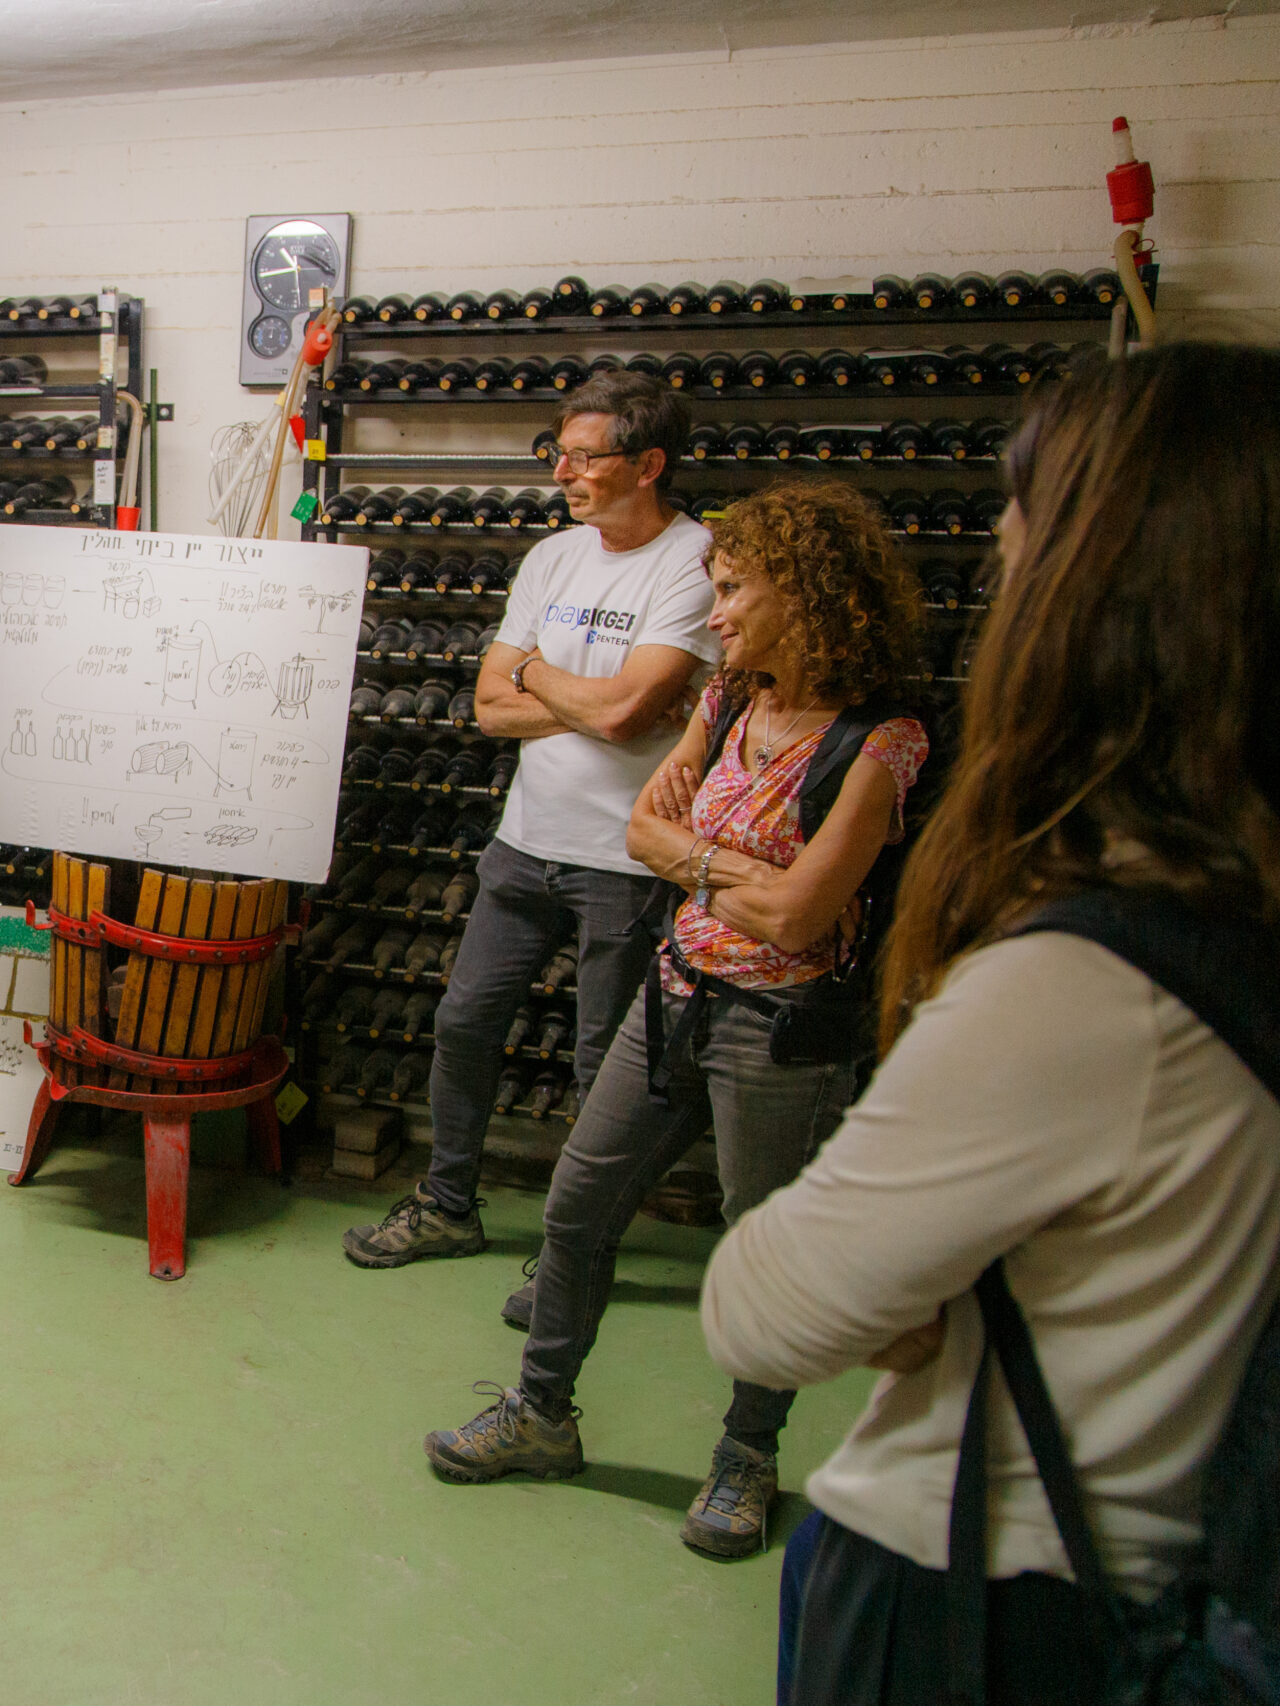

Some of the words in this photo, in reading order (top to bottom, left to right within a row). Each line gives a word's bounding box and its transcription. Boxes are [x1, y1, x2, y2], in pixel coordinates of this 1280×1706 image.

[81, 531, 122, 552] תהליך
[136, 538, 175, 559] ביתי
[185, 542, 202, 559] יין
[214, 543, 263, 565] ייצור
